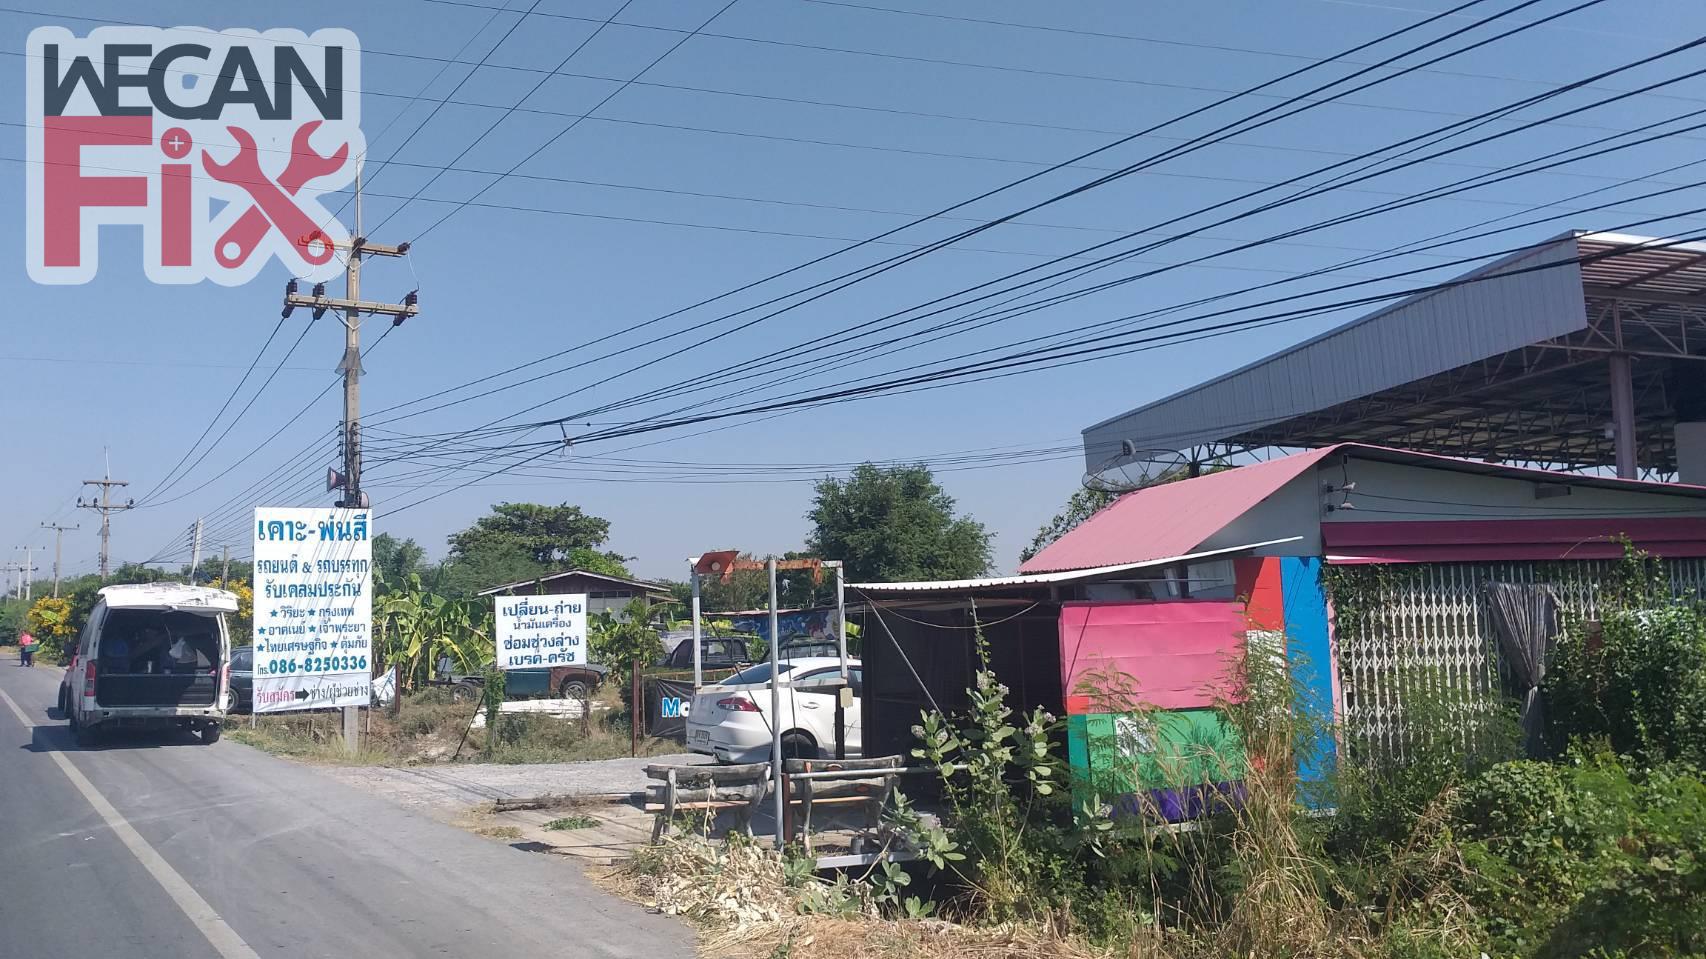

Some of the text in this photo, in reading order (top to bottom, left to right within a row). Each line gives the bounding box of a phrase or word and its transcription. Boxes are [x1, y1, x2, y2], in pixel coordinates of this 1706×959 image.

[258, 514, 367, 541] เคาะ-พ่นสี
[257, 553, 367, 578] รถยนต์ & รถบรรทุก
[265, 578, 361, 598] รับเคลมประกัน
[319, 607, 354, 622] กรุงเทพ
[502, 597, 581, 616] เปลี่ยน-ถ่าย
[319, 620, 366, 633] เจ้าพระยา
[513, 615, 571, 630] น้ำมันเครื่อง
[265, 638, 327, 655] ไทยเศรษฐกิจ
[504, 632, 579, 650] ซ่อมช่วงล่าง
[256, 686, 296, 704] รับสมัคร
